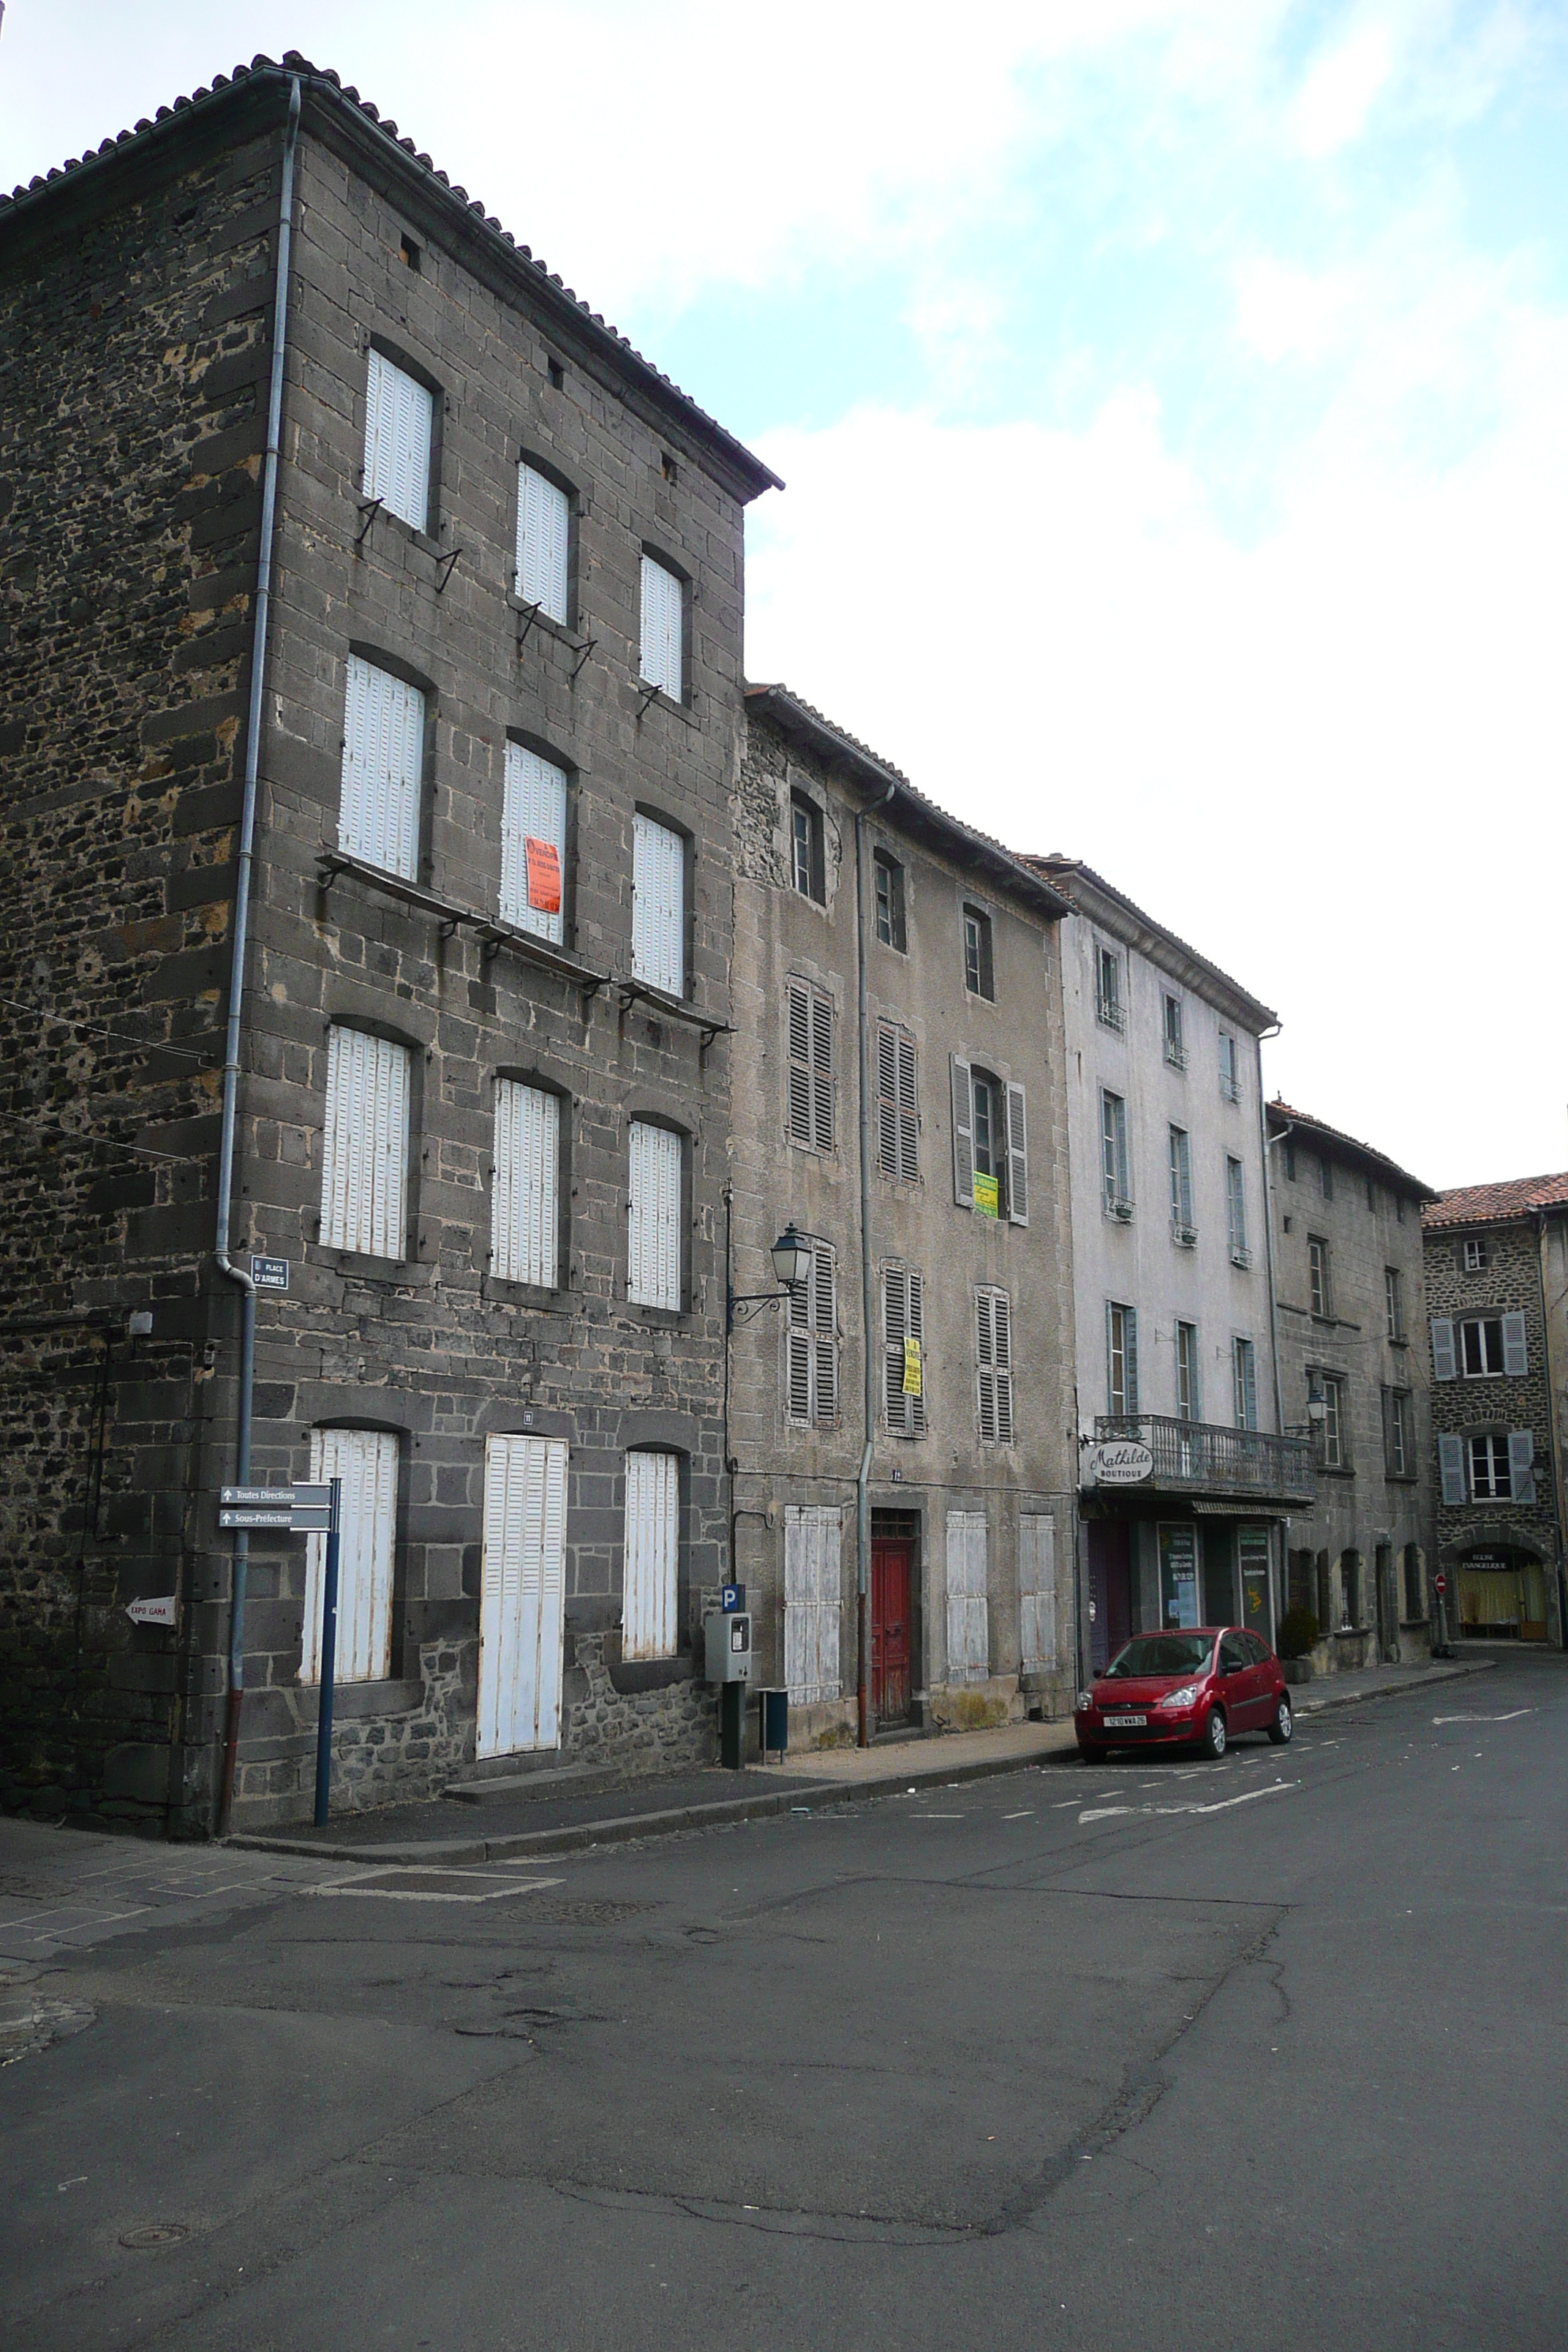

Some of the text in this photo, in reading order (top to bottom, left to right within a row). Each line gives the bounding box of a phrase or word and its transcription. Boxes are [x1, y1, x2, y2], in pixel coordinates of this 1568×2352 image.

[535, 848, 559, 862] VENDRE
[978, 1177, 997, 1191] VENDRE
[265, 1264, 284, 1273] PLACE
[255, 1273, 284, 1285] D'ARMES
[1090, 1448, 1150, 1470] Mathilde
[235, 1490, 295, 1500] Toutes Directions
[235, 1514, 292, 1523] Sous-Préfecture
[724, 1589, 736, 1607] P
[131, 1606, 146, 1615] EXPO
